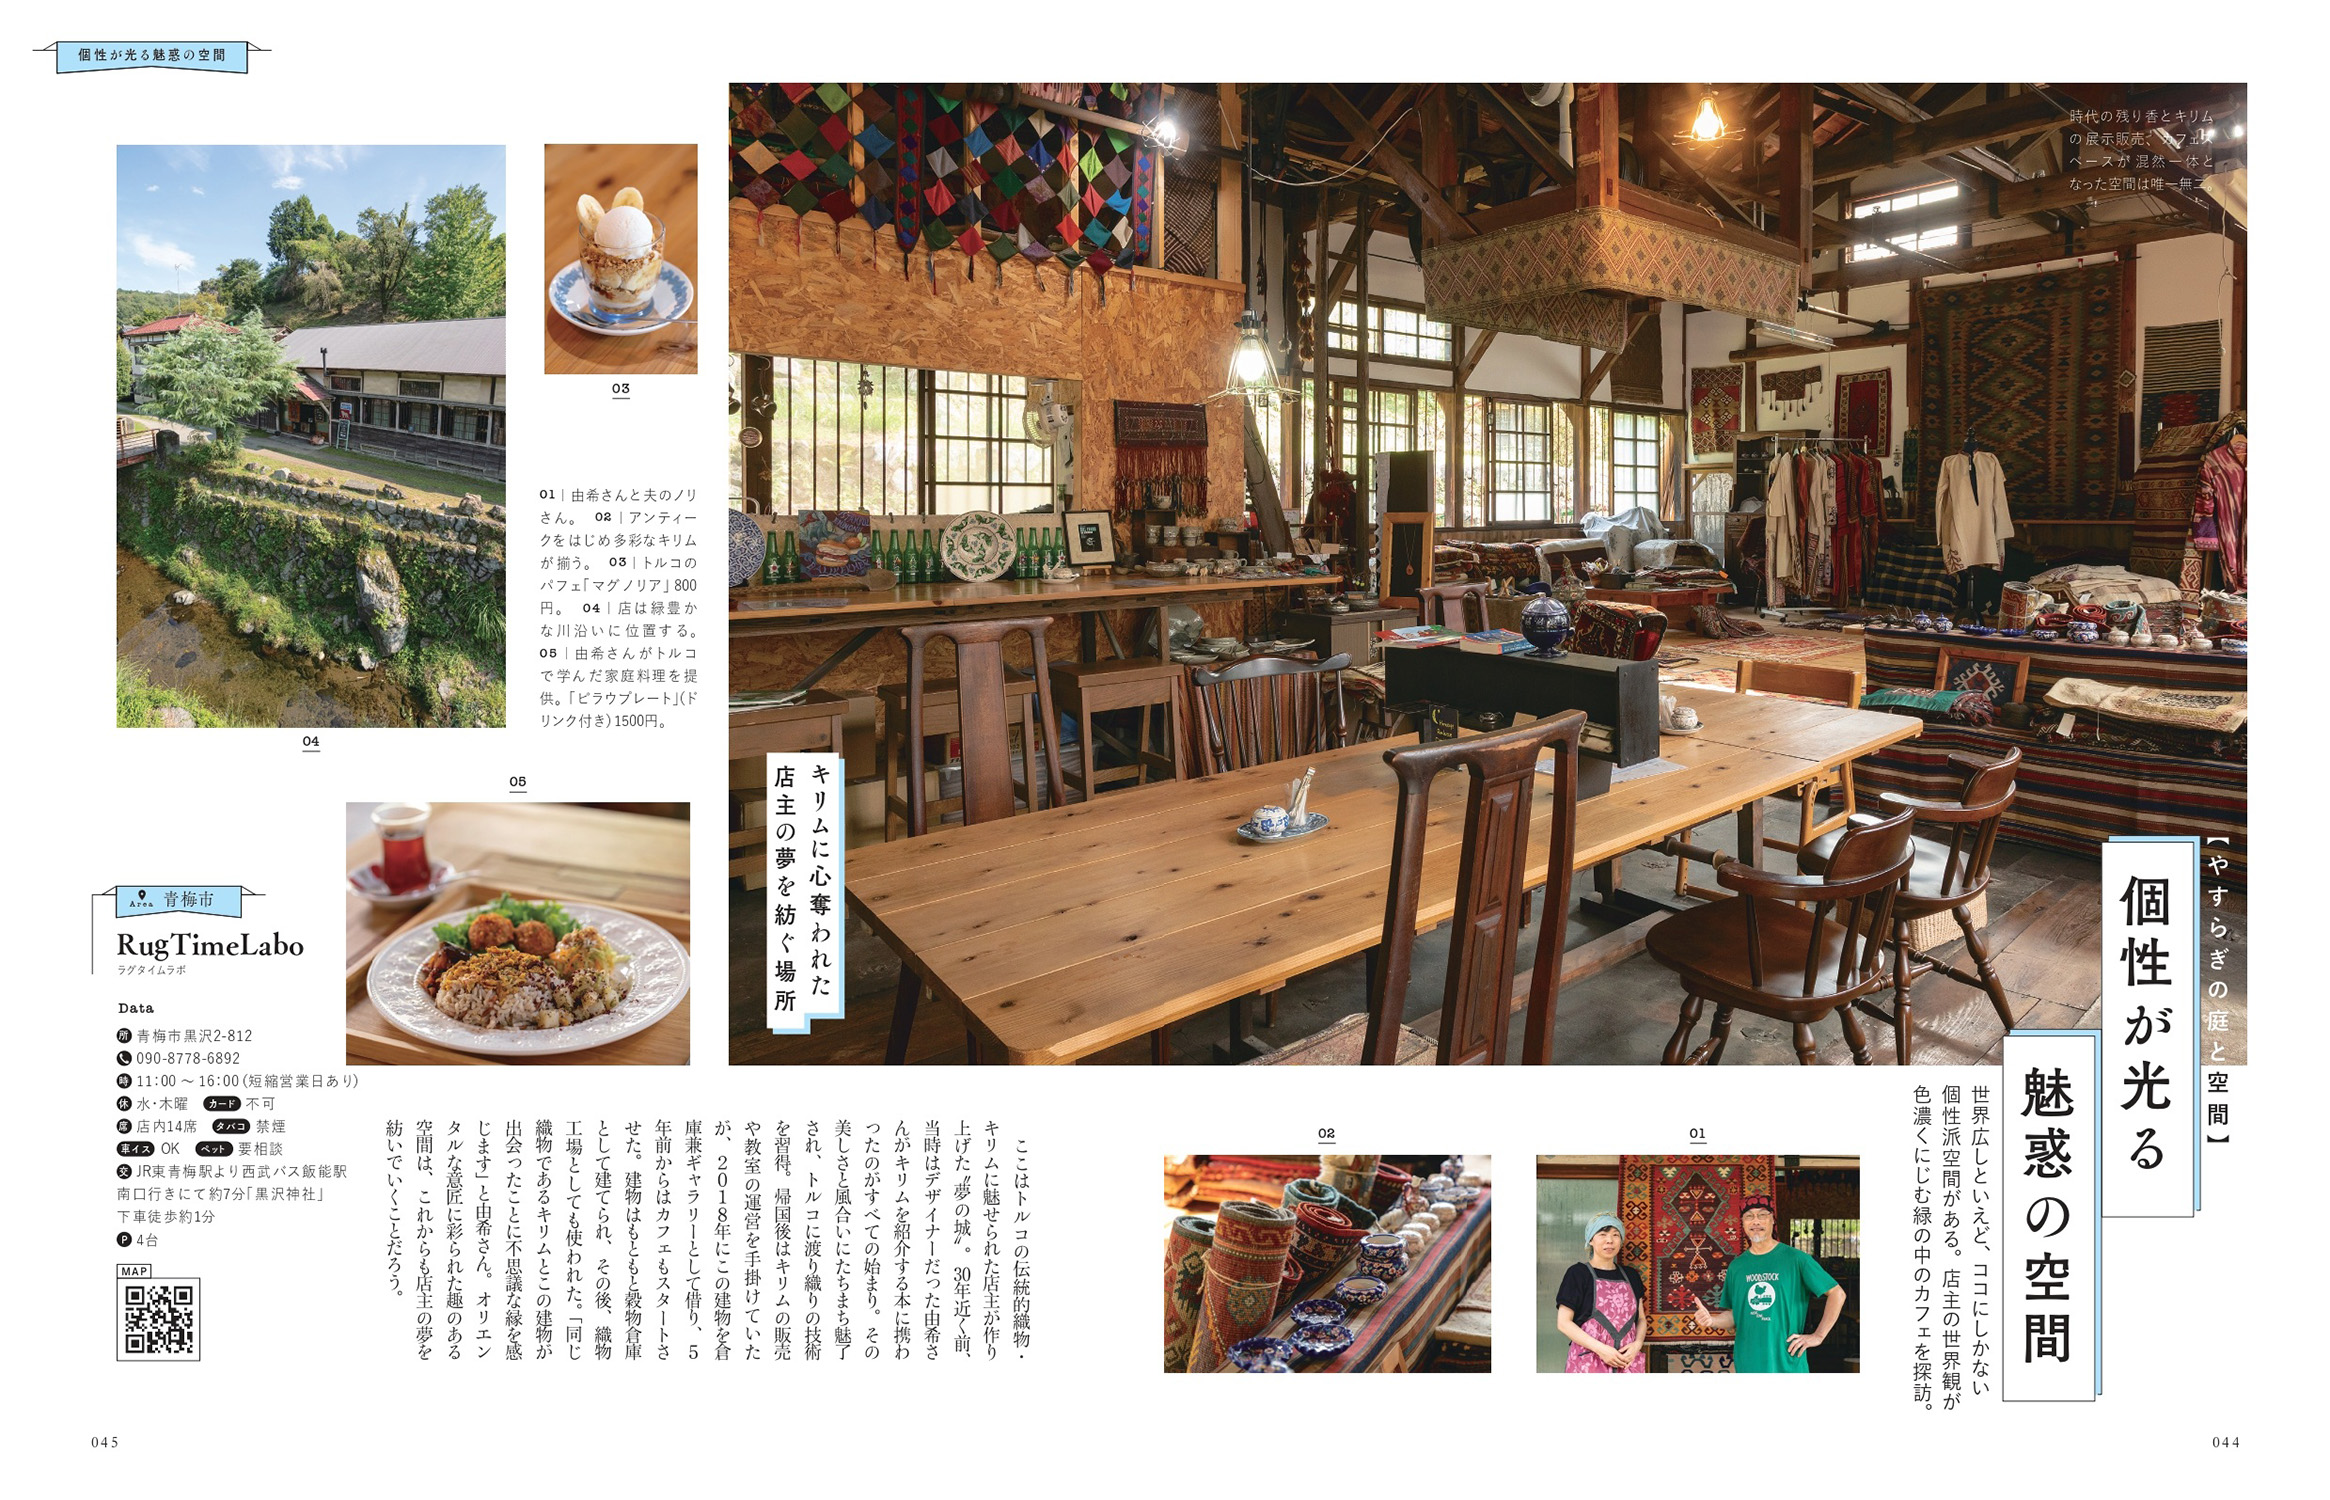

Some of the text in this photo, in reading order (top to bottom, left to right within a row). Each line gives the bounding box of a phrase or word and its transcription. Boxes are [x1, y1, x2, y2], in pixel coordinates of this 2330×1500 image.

[78, 47, 226, 62] 個性が光る魅惑の空間
[612, 383, 629, 393] 03
[541, 534, 696, 548] クをはじめ多彩なキリム
[541, 624, 695, 638] な川沿いに位置する。
[541, 669, 697, 683] で学んだ家庭料理を提
[303, 736, 319, 746] 04
[510, 777, 526, 786] 05
[809, 764, 832, 996] キリムに心奪われた
[774, 765, 797, 1012] 店主の夢を紡ぐ場所
[164, 891, 214, 908] 青梅市
[117, 932, 304, 961] RugTimeLabo
[119, 965, 185, 975] ラグタイムラボ
[118, 1003, 154, 1013] Data
[2120, 876, 2172, 1169] 個性が光る
[138, 1029, 251, 1043] 青梅市黒沢2-812
[137, 1052, 239, 1064] 090-8778-6892
[209, 1099, 236, 1109] カード
[246, 1097, 275, 1110] 不可
[137, 1119, 196, 1133] 店内14席
[216, 1121, 246, 1131] タバコ
[257, 1119, 285, 1133] 禁煙
[1318, 1128, 1335, 1138] 02
[1690, 1128, 1705, 1138] 01
[121, 1142, 282, 1156] 車イス OK ペット 要相談
[137, 1164, 346, 1179] JR東青梅駅より西武バス飯能駅
[117, 1210, 215, 1224] 下車徒歩約1分
[2021, 1067, 2074, 1363] 魅惑の空間
[137, 1233, 157, 1247] 4台
[447, 1121, 463, 1359] タルな意匠に彩られた趣のある
[506, 1120, 522, 1360] 出会ったことに不思議な縁を感
[536, 1119, 552, 1359] 織物であるキリムとこの建物が
[655, 1119, 672, 1360] 年前からはカフェもスタートさ
[745, 1121, 761, 1360] や教室の運営を手掛けていた
[835, 1120, 851, 1360] 美しさと風合いにたちまち魅了
[894, 1120, 910, 1360] んがキリムを紹介する本に携わ
[925, 1120, 941, 1360] 当時はデザイナーだった由希さ
[983, 1121, 1000, 1360] キリムに魅せられた店主が作り
[121, 1267, 148, 1276] MAP
[1746, 1273, 1779, 1282] WOODSTOCK
[92, 1437, 118, 1448] 045
[2213, 1437, 2239, 1448] 044
